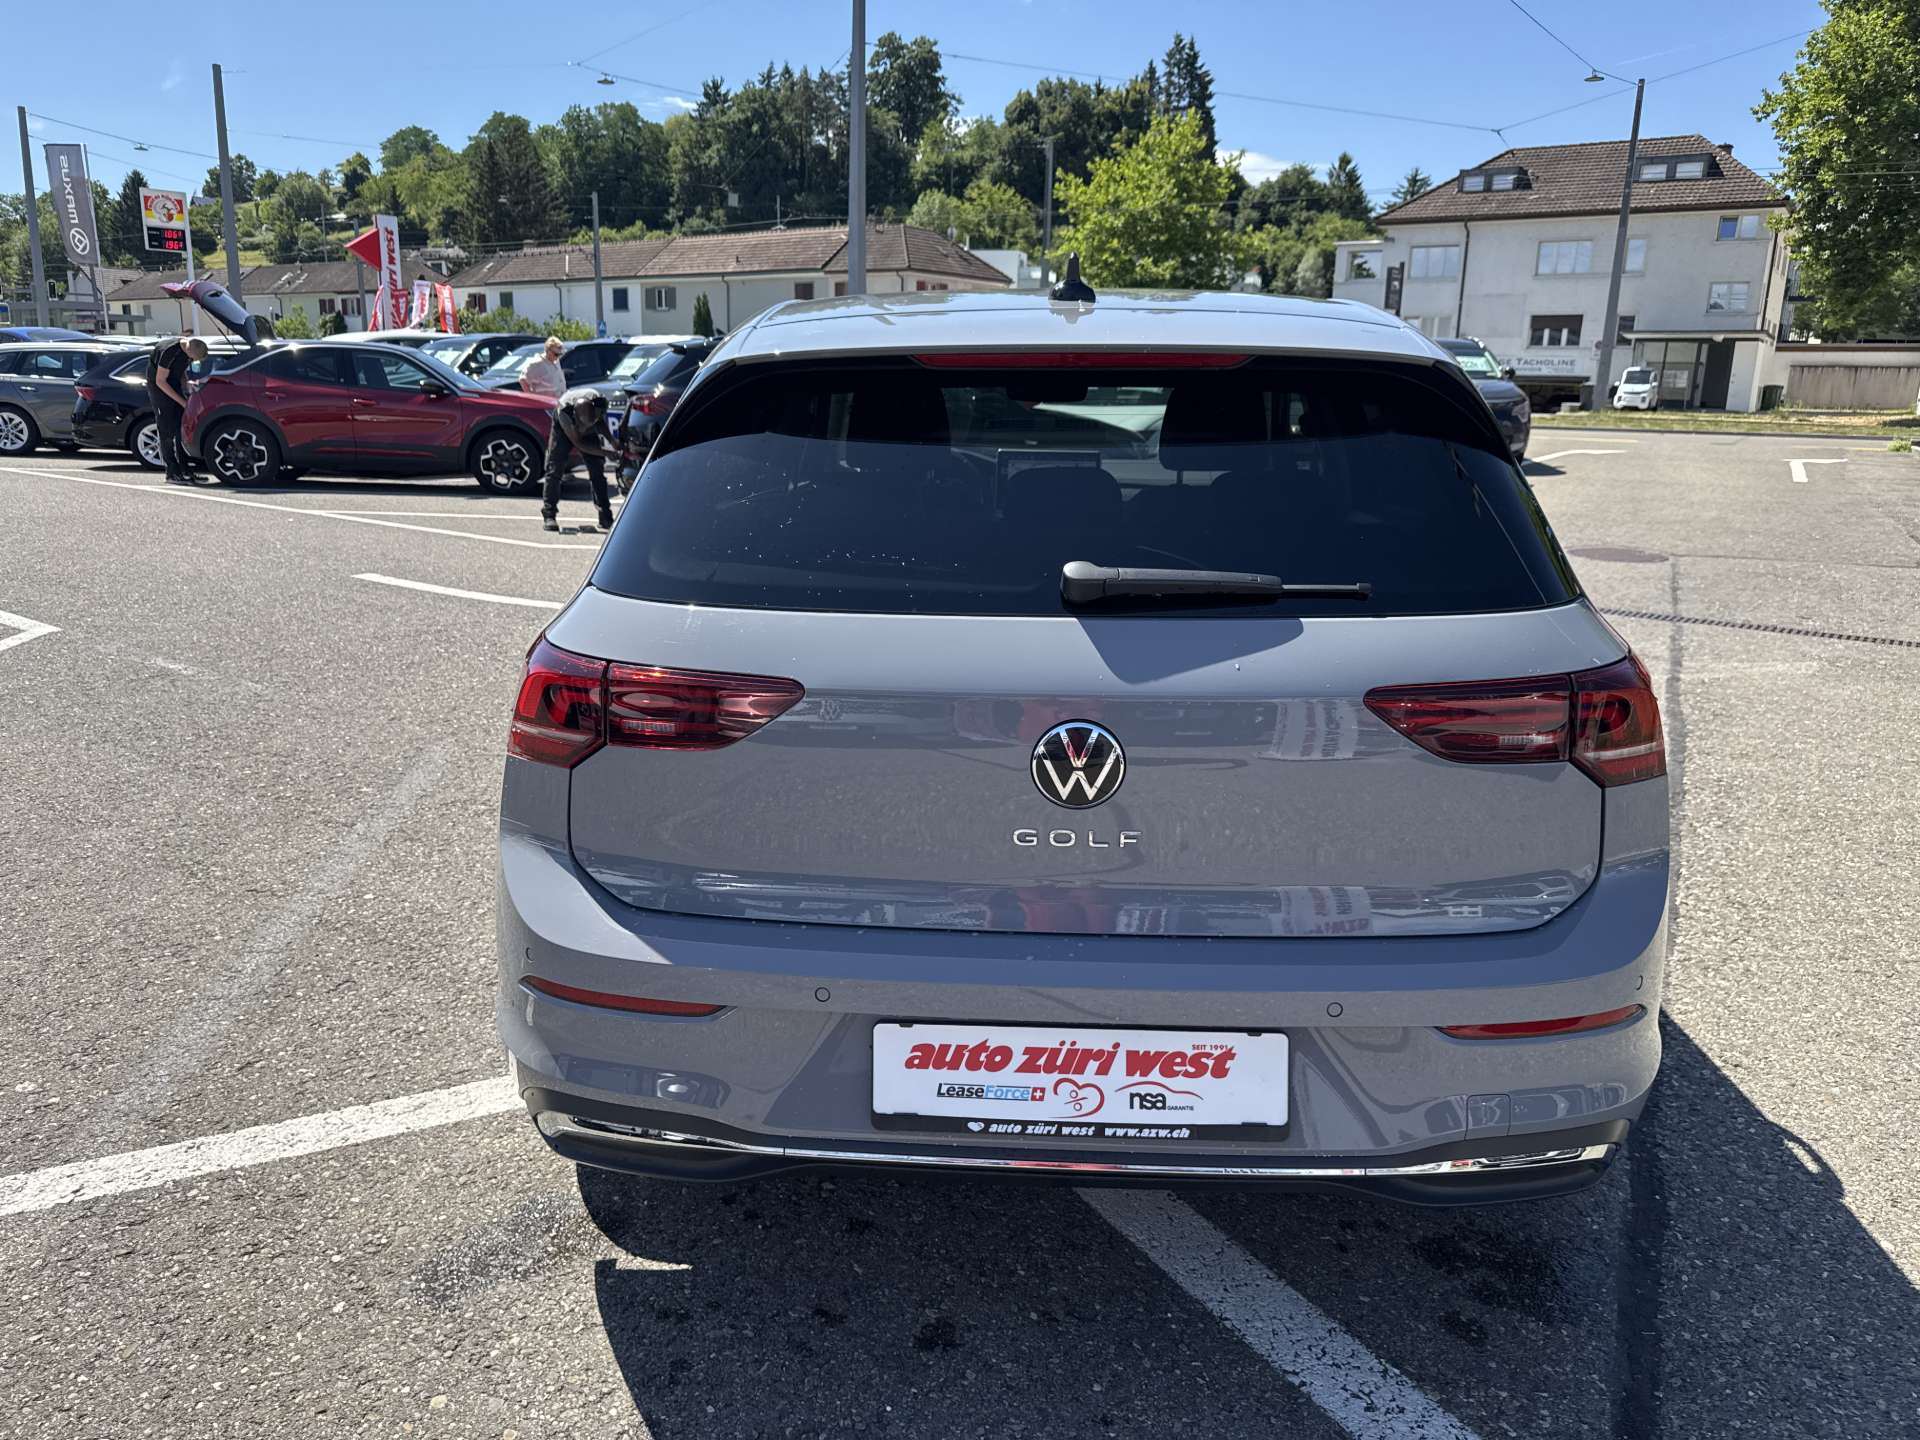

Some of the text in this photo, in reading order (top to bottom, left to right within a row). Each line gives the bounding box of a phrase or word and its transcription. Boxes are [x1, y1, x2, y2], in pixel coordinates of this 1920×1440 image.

[385, 227, 396, 265] west
[1013, 829, 1141, 848] GOLF
[904, 1038, 1237, 1079] auto züri west
[937, 1083, 1031, 1100] LeaseForce
[1129, 1092, 1166, 1111] nsa
[989, 1123, 1022, 1134] auto
[1061, 1125, 1095, 1136] west
[1104, 1126, 1190, 1138] www.azw.ch
